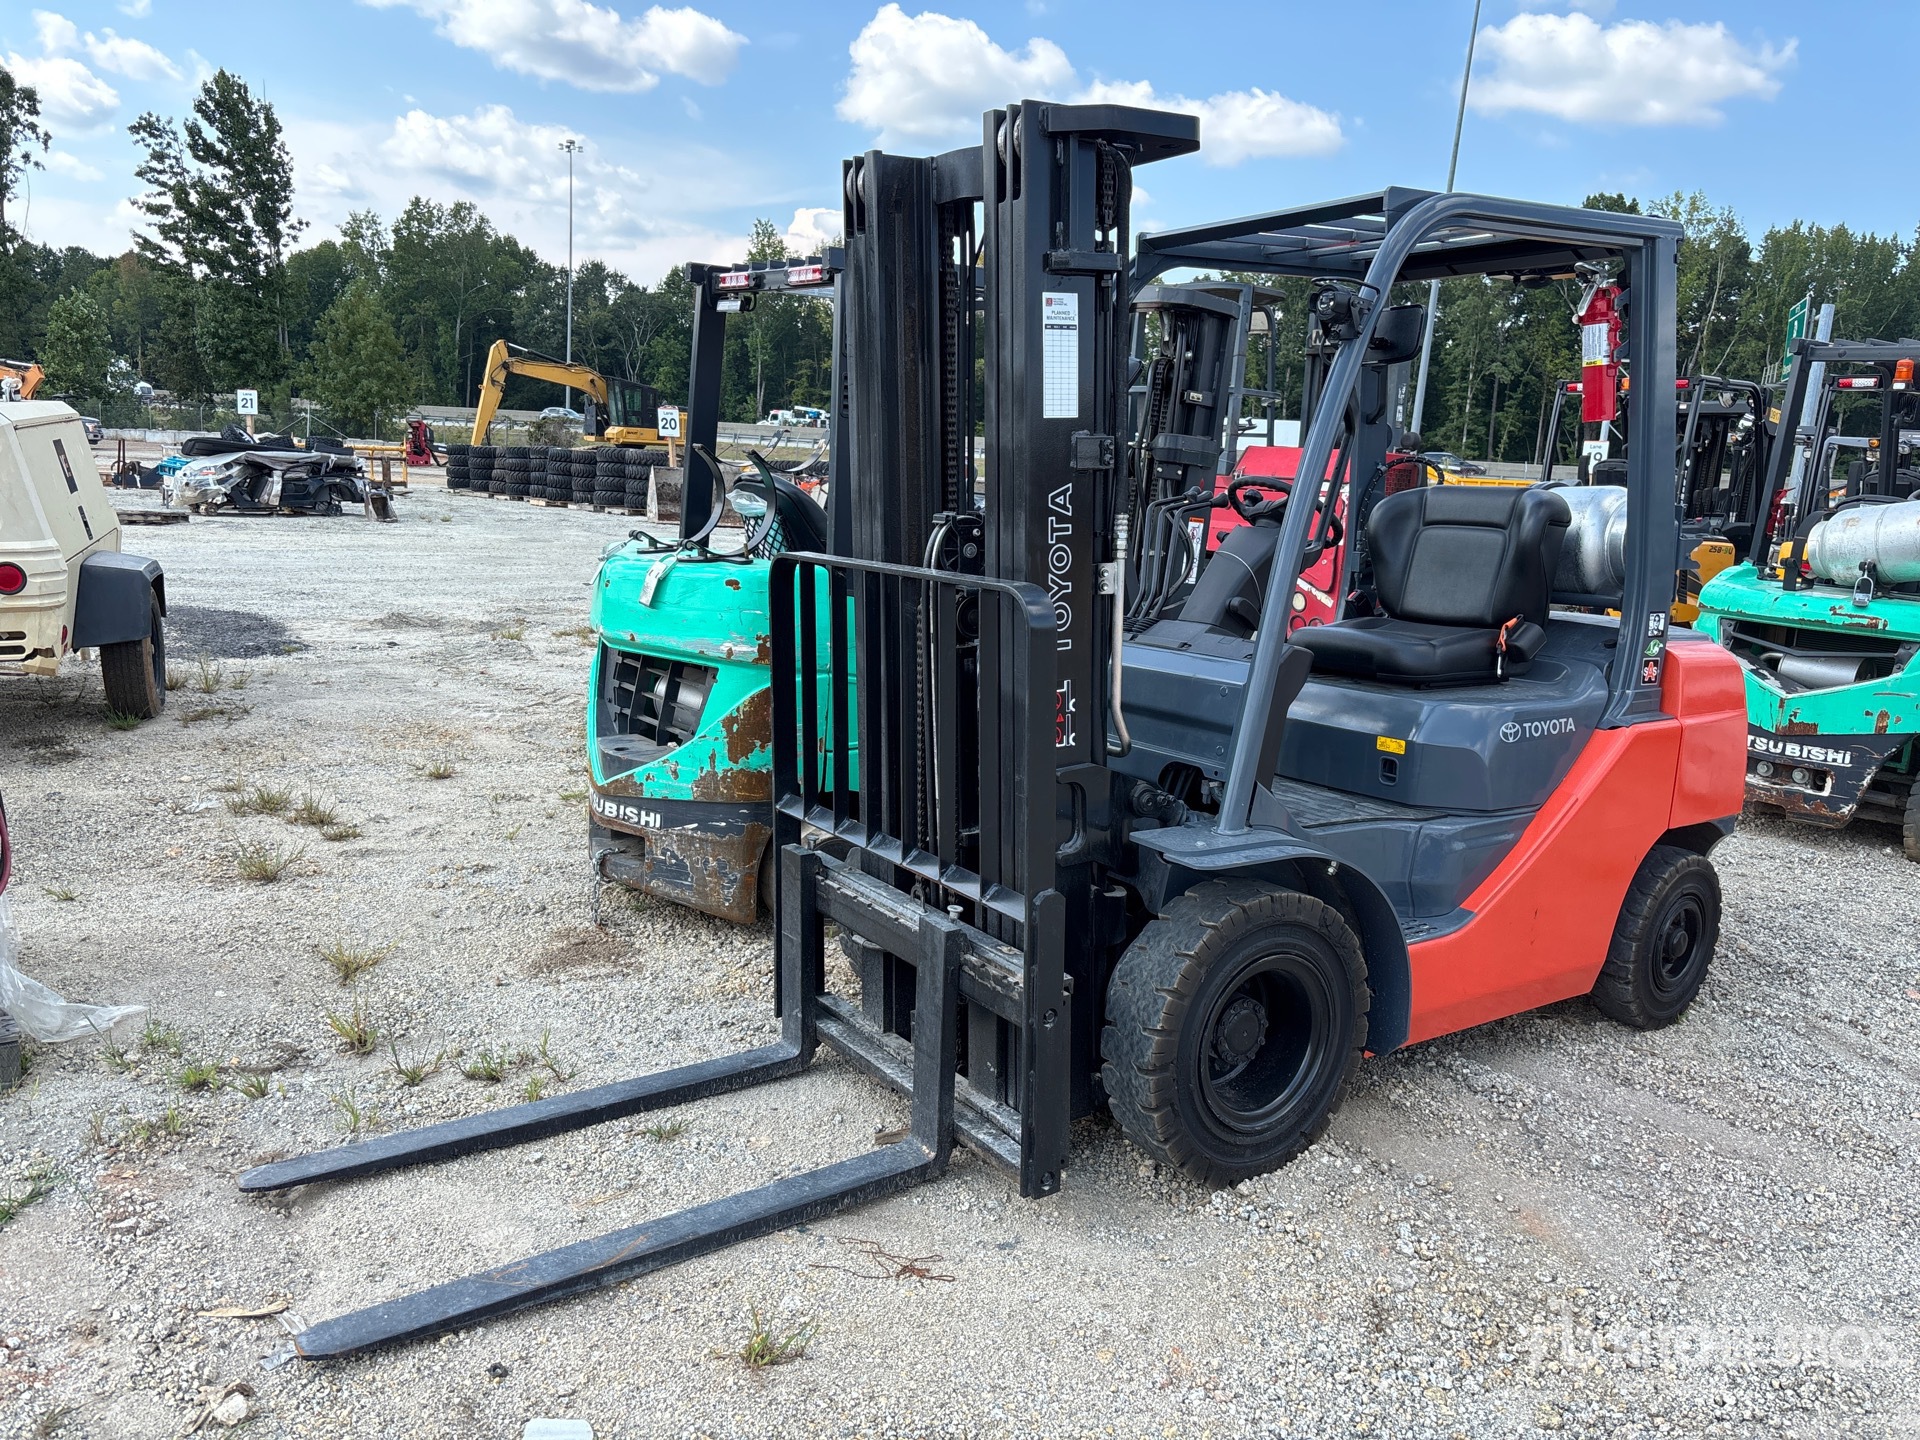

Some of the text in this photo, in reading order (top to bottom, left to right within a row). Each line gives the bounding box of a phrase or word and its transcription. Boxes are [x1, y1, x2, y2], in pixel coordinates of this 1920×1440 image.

[240, 397, 254, 409] 21
[660, 417, 677, 430] 20
[1522, 717, 1576, 738] TOYOTA
